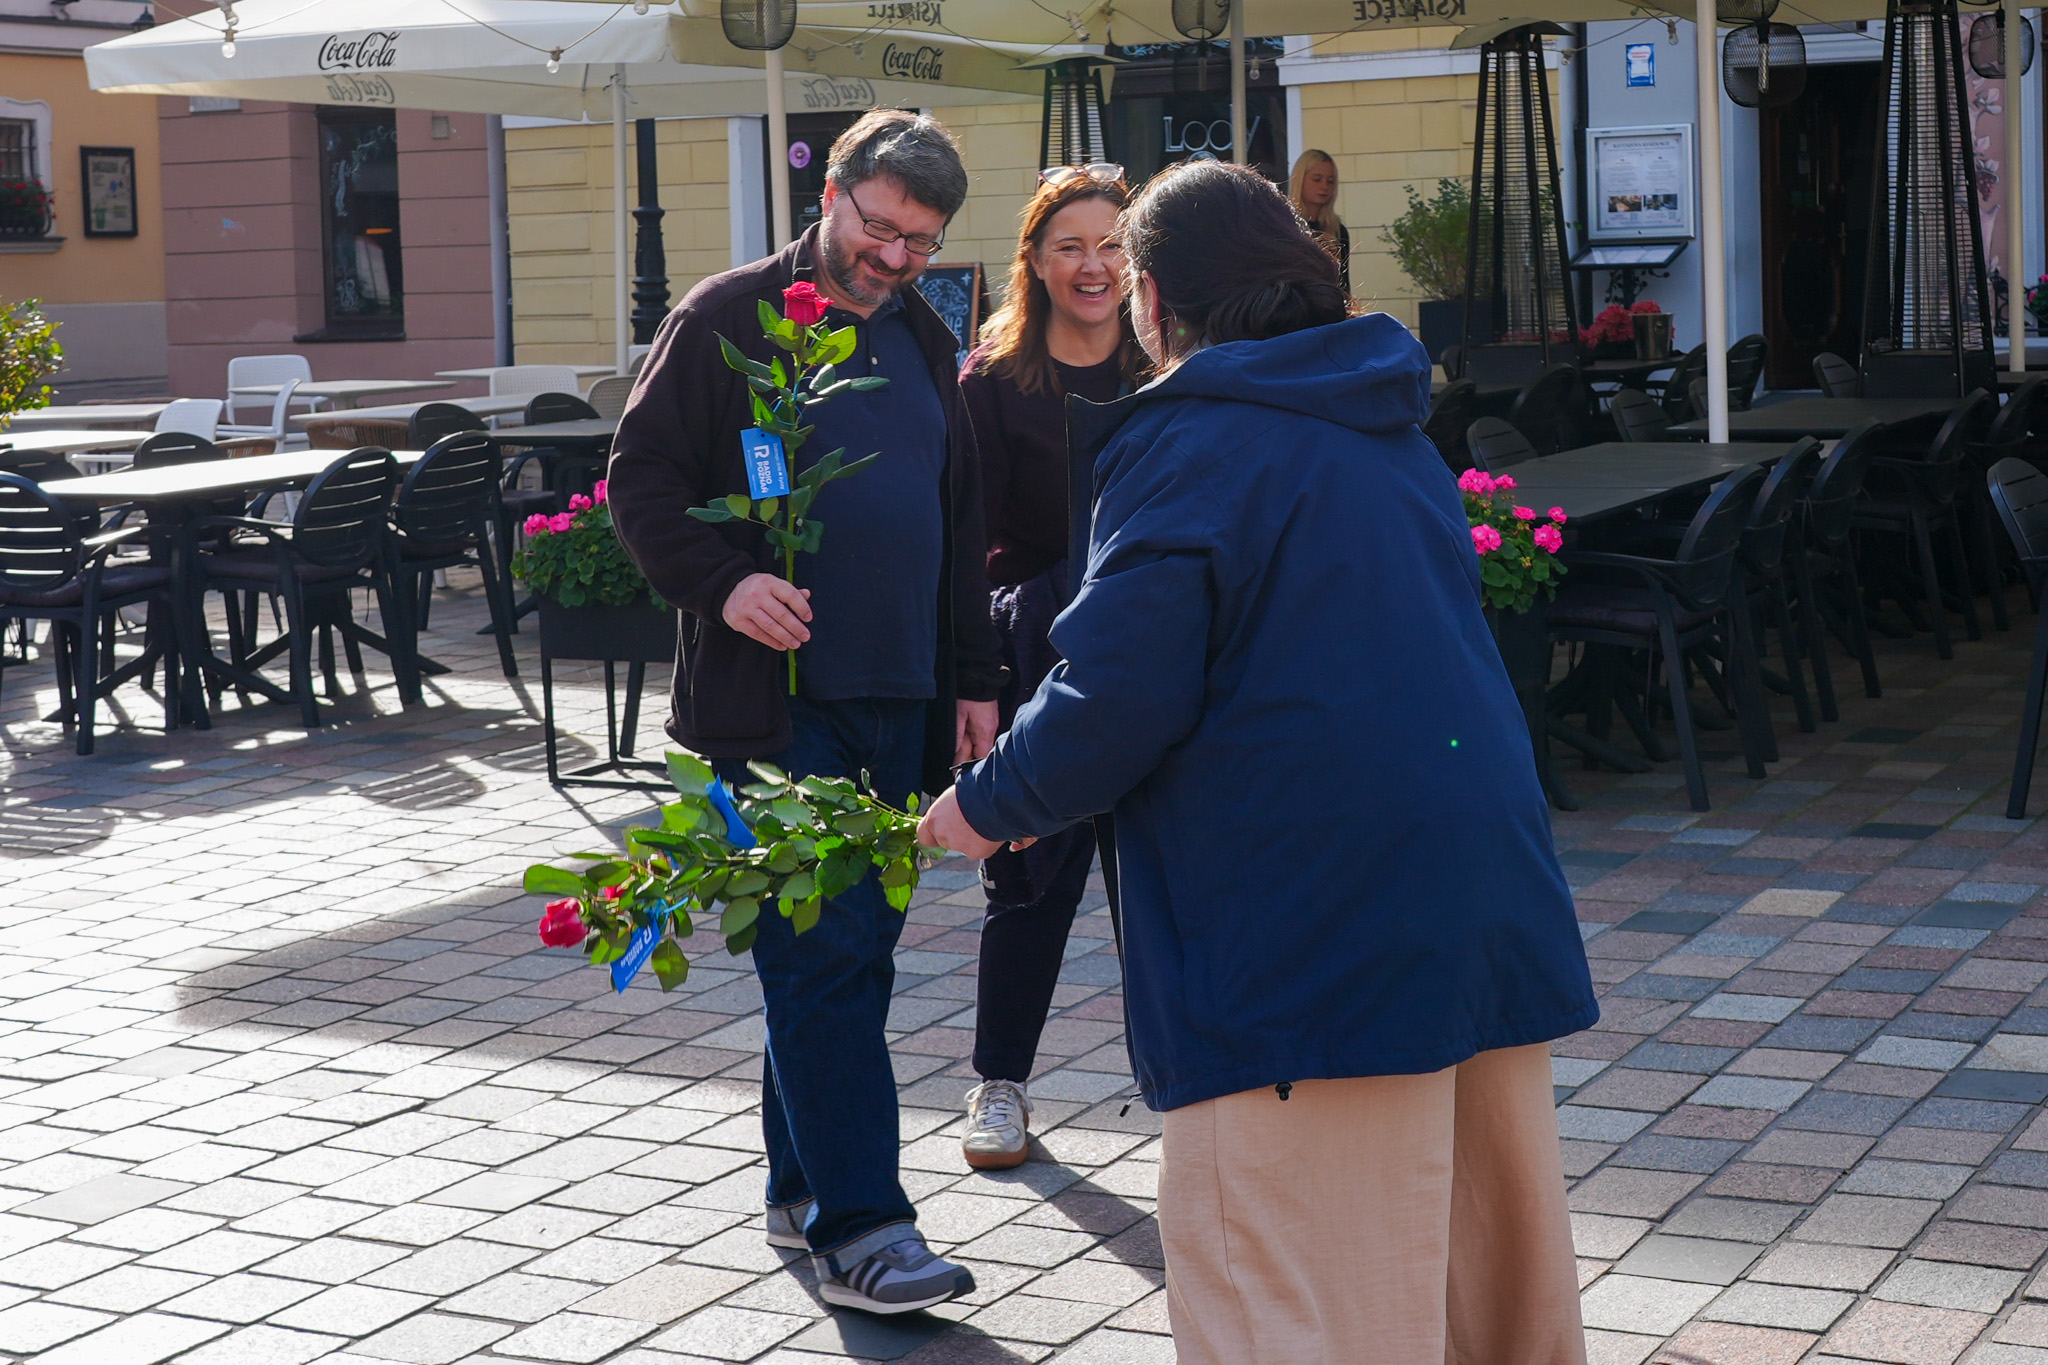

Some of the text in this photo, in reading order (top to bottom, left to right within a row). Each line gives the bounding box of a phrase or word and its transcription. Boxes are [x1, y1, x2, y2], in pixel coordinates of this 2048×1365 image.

[318, 31, 401, 70] Coca-Cola
[882, 43, 944, 80] Coca-Cola
[757, 461, 769, 493] POZNAŃ
[762, 460, 773, 485] RADIO
